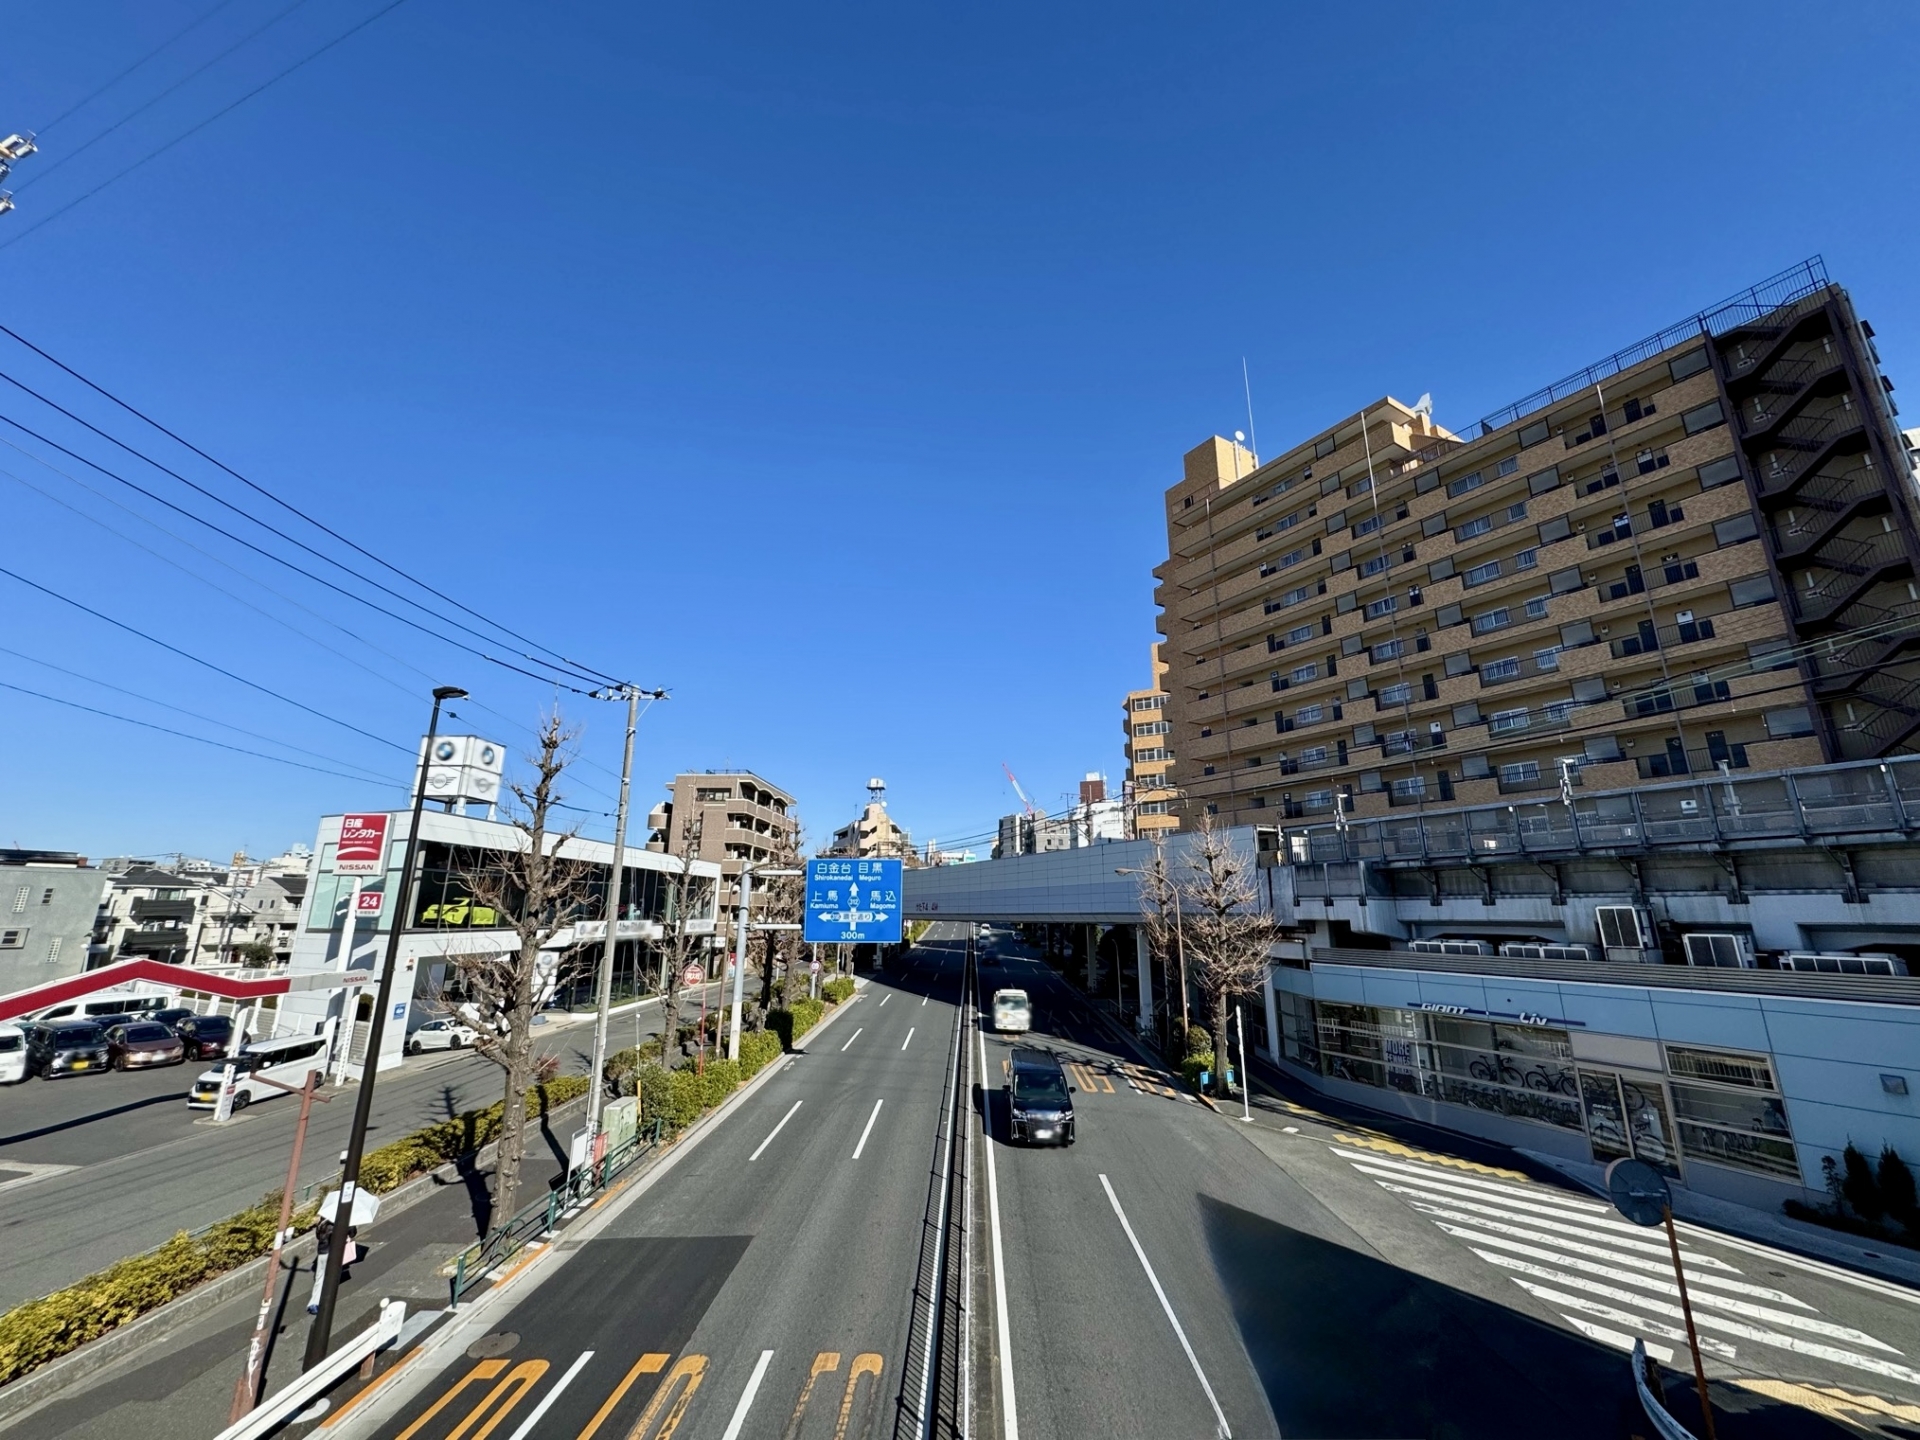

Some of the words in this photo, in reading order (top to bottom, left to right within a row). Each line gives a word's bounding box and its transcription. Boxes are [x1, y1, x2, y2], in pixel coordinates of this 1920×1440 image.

[345, 818, 364, 829] 日産
[342, 829, 382, 839] レンタカー
[817, 862, 852, 874] 白金台
[858, 862, 883, 874] 目黒
[858, 874, 882, 882] Meguro
[361, 896, 378, 907] 24
[811, 890, 839, 902] 上馬
[870, 890, 897, 902] 馬込
[841, 931, 865, 940] 300m
[343, 976, 368, 984] NISSAN
[1421, 1002, 1469, 1015] GIANT
[1519, 1012, 1548, 1026] Liv
[1386, 1039, 1410, 1056] MORE
